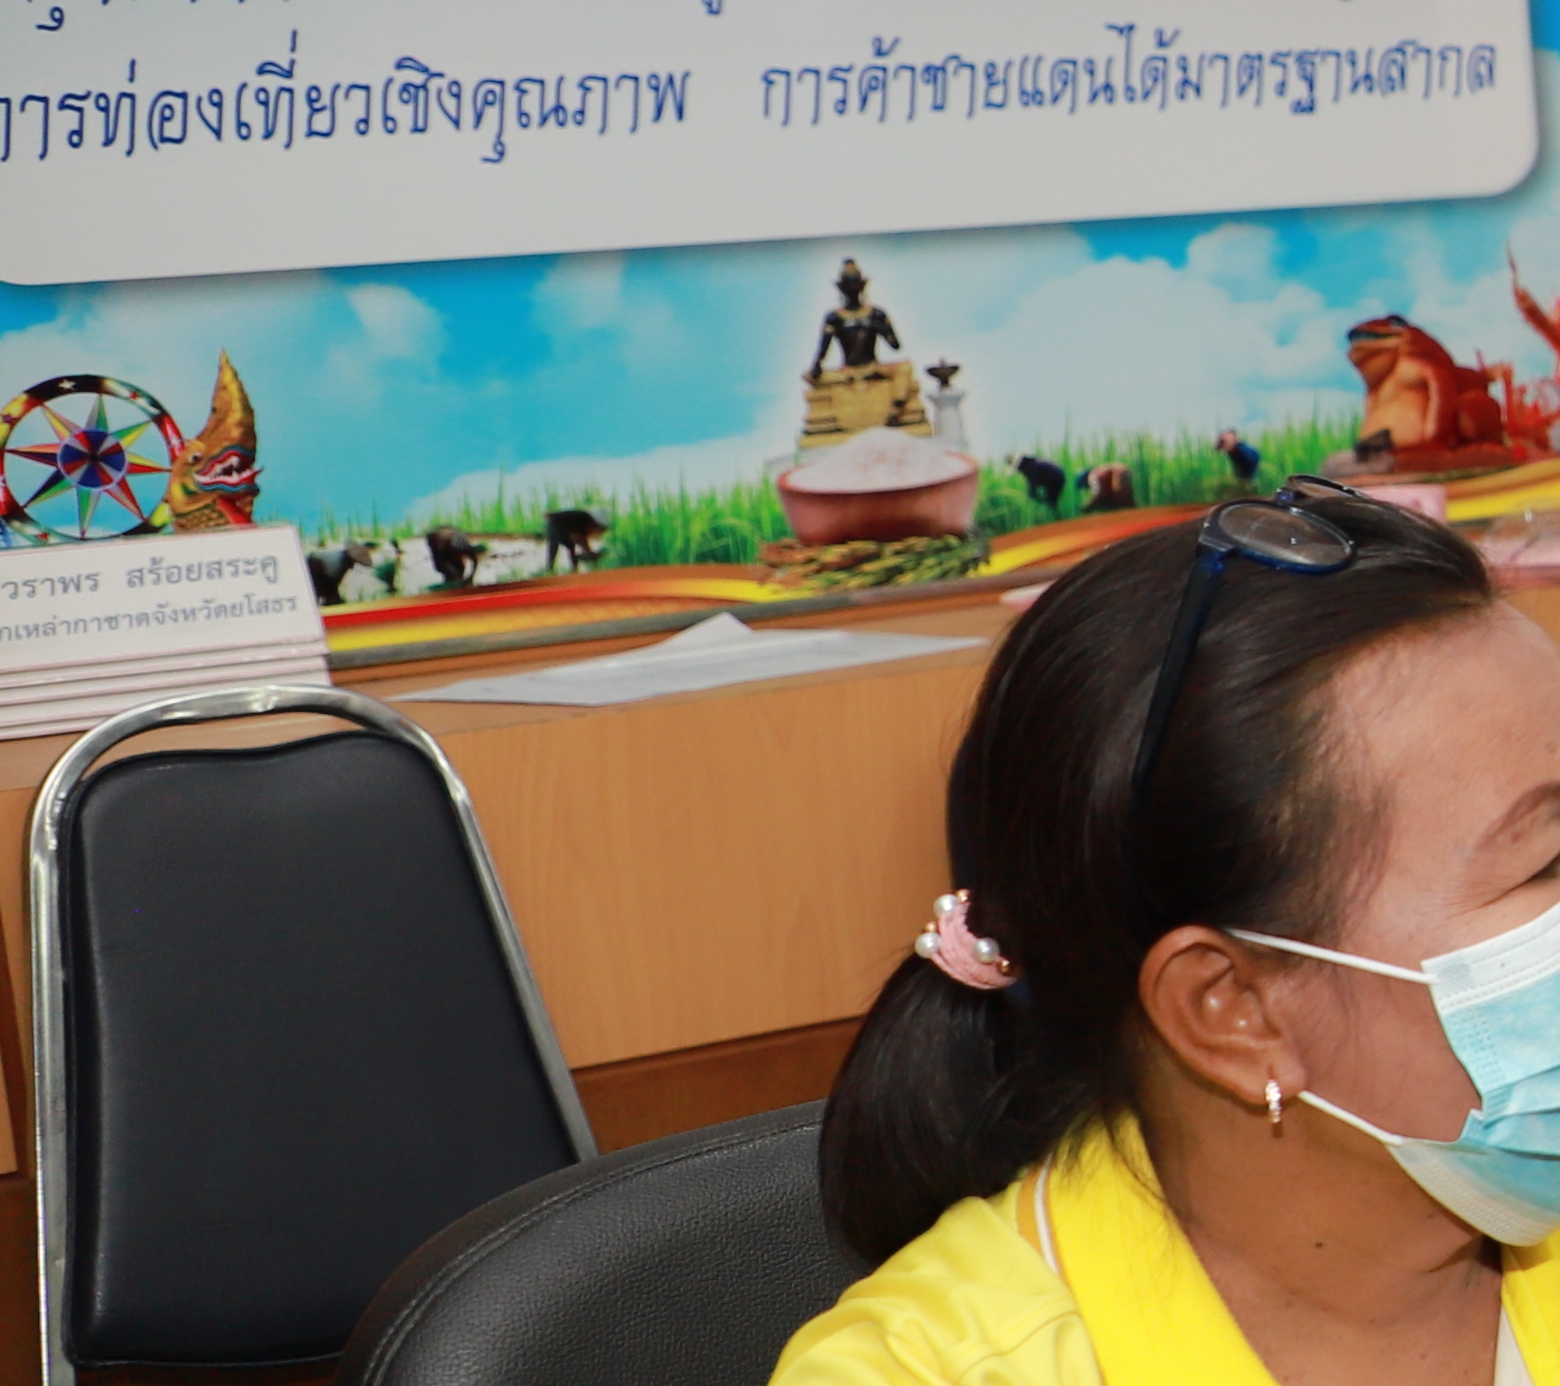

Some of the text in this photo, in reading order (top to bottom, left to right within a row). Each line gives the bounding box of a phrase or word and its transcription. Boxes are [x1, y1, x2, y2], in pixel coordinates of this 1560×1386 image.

[760, 23, 1497, 126] การค้าชายแดนได้มาตรฐานสากล
[126, 550, 280, 589] สร้อยสระคู
